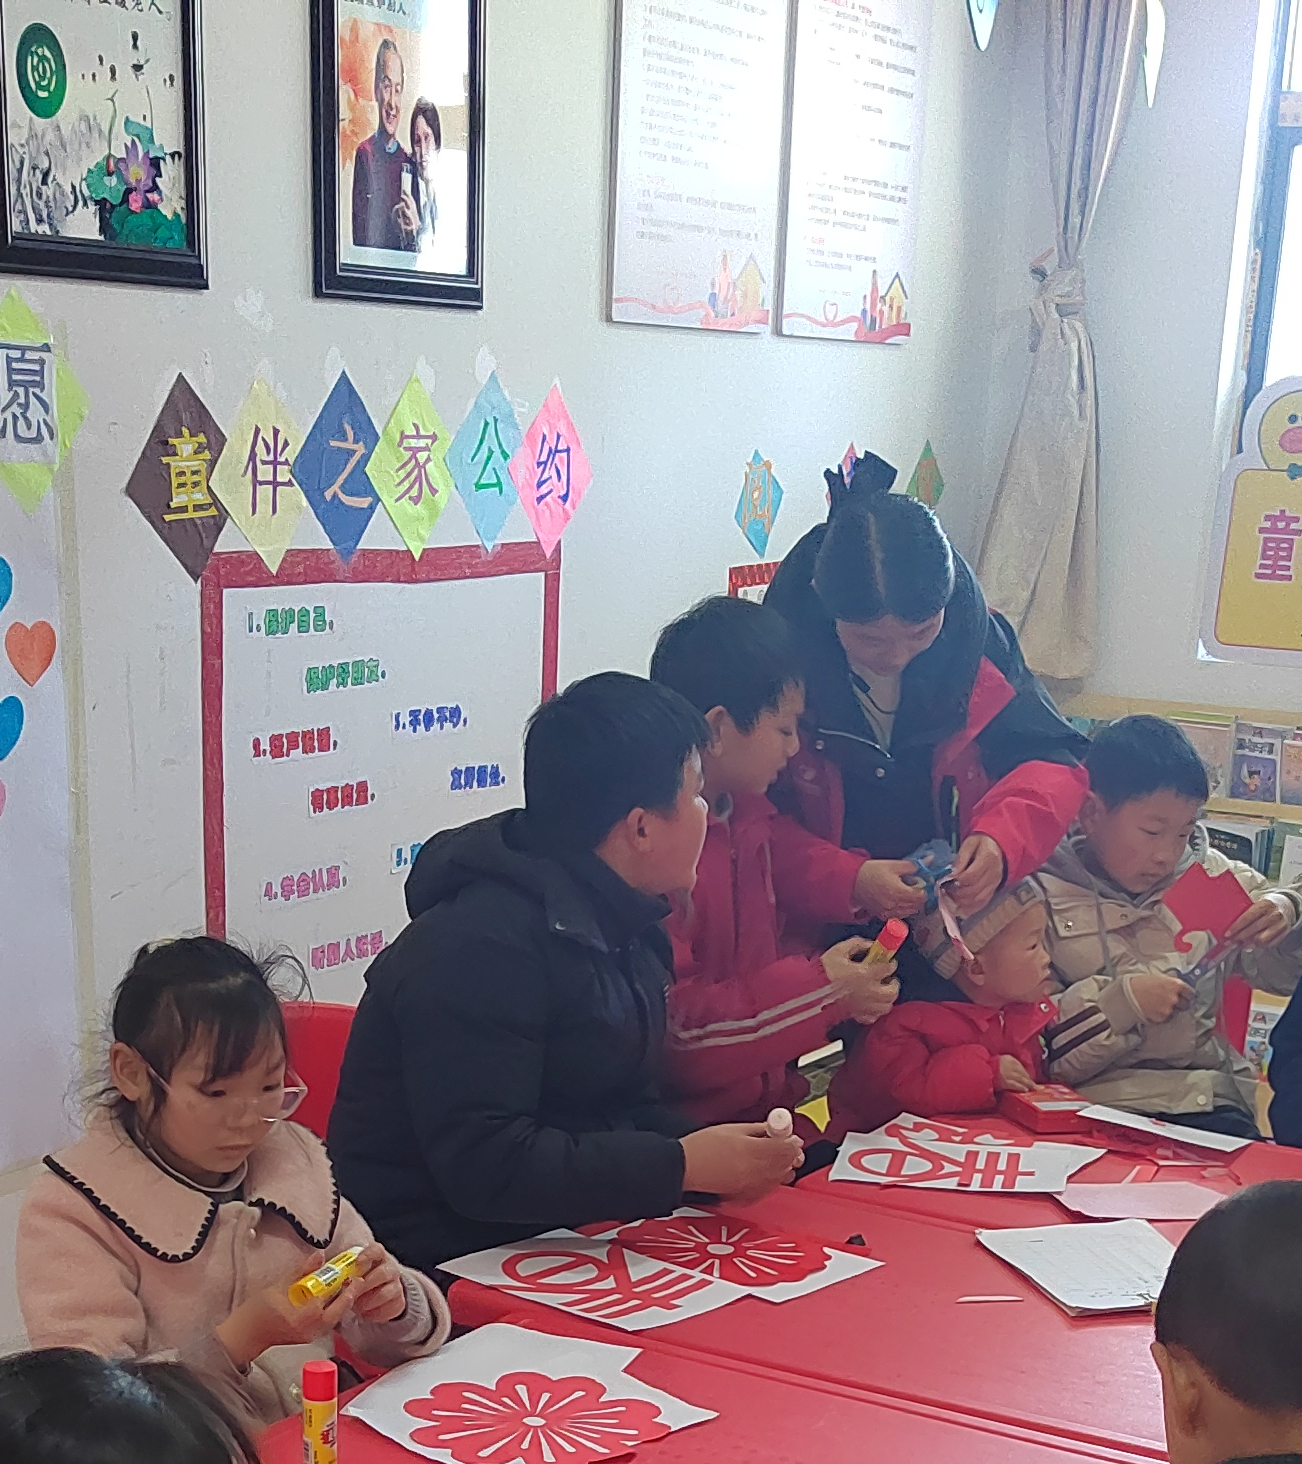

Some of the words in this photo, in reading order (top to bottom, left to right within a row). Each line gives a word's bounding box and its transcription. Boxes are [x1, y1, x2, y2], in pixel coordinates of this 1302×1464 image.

[161, 417, 571, 522] 童伴之家公约
